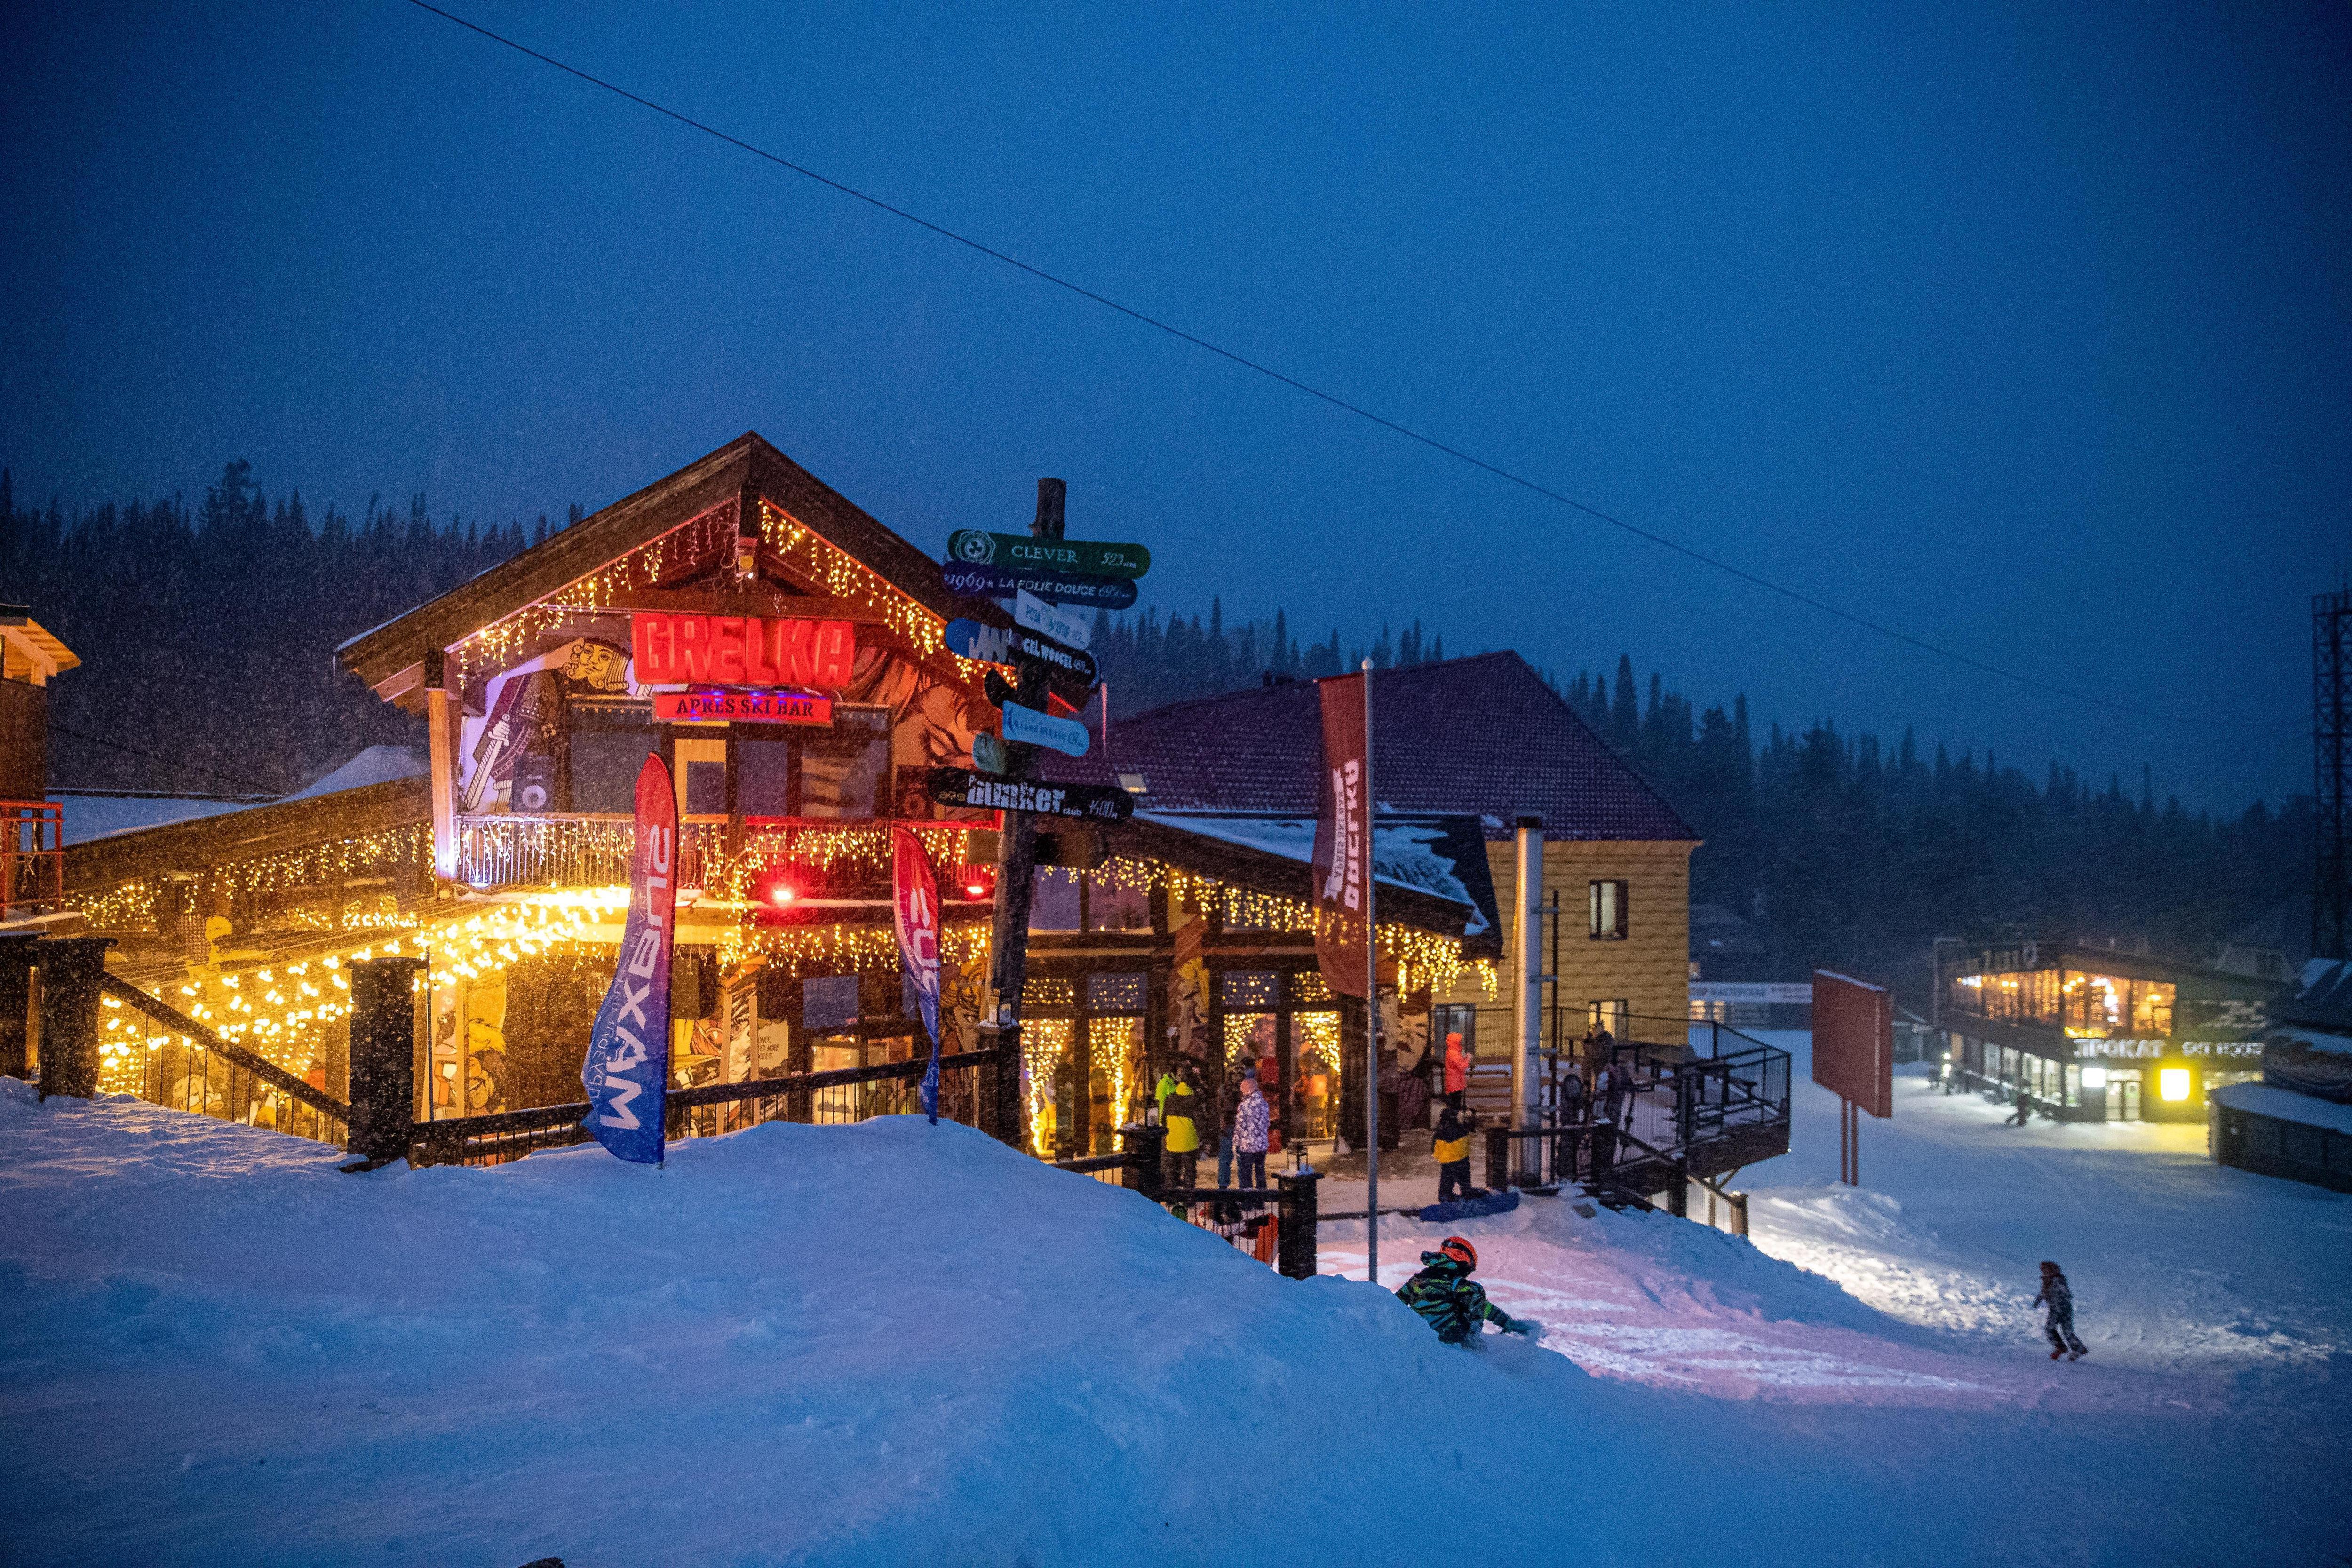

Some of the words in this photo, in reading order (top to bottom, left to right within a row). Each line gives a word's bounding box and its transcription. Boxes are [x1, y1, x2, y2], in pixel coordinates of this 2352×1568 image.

[1011, 544, 1078, 563] CLEVER
[999, 578, 1015, 588] LA
[1017, 579, 1052, 592] FOLIE
[1054, 582, 1097, 597] DOUCE
[631, 613, 856, 687] GRELKA
[677, 698, 735, 716] APRES
[740, 699, 771, 716] SKI
[777, 700, 814, 717] BAR
[967, 775, 1066, 813] bunker
